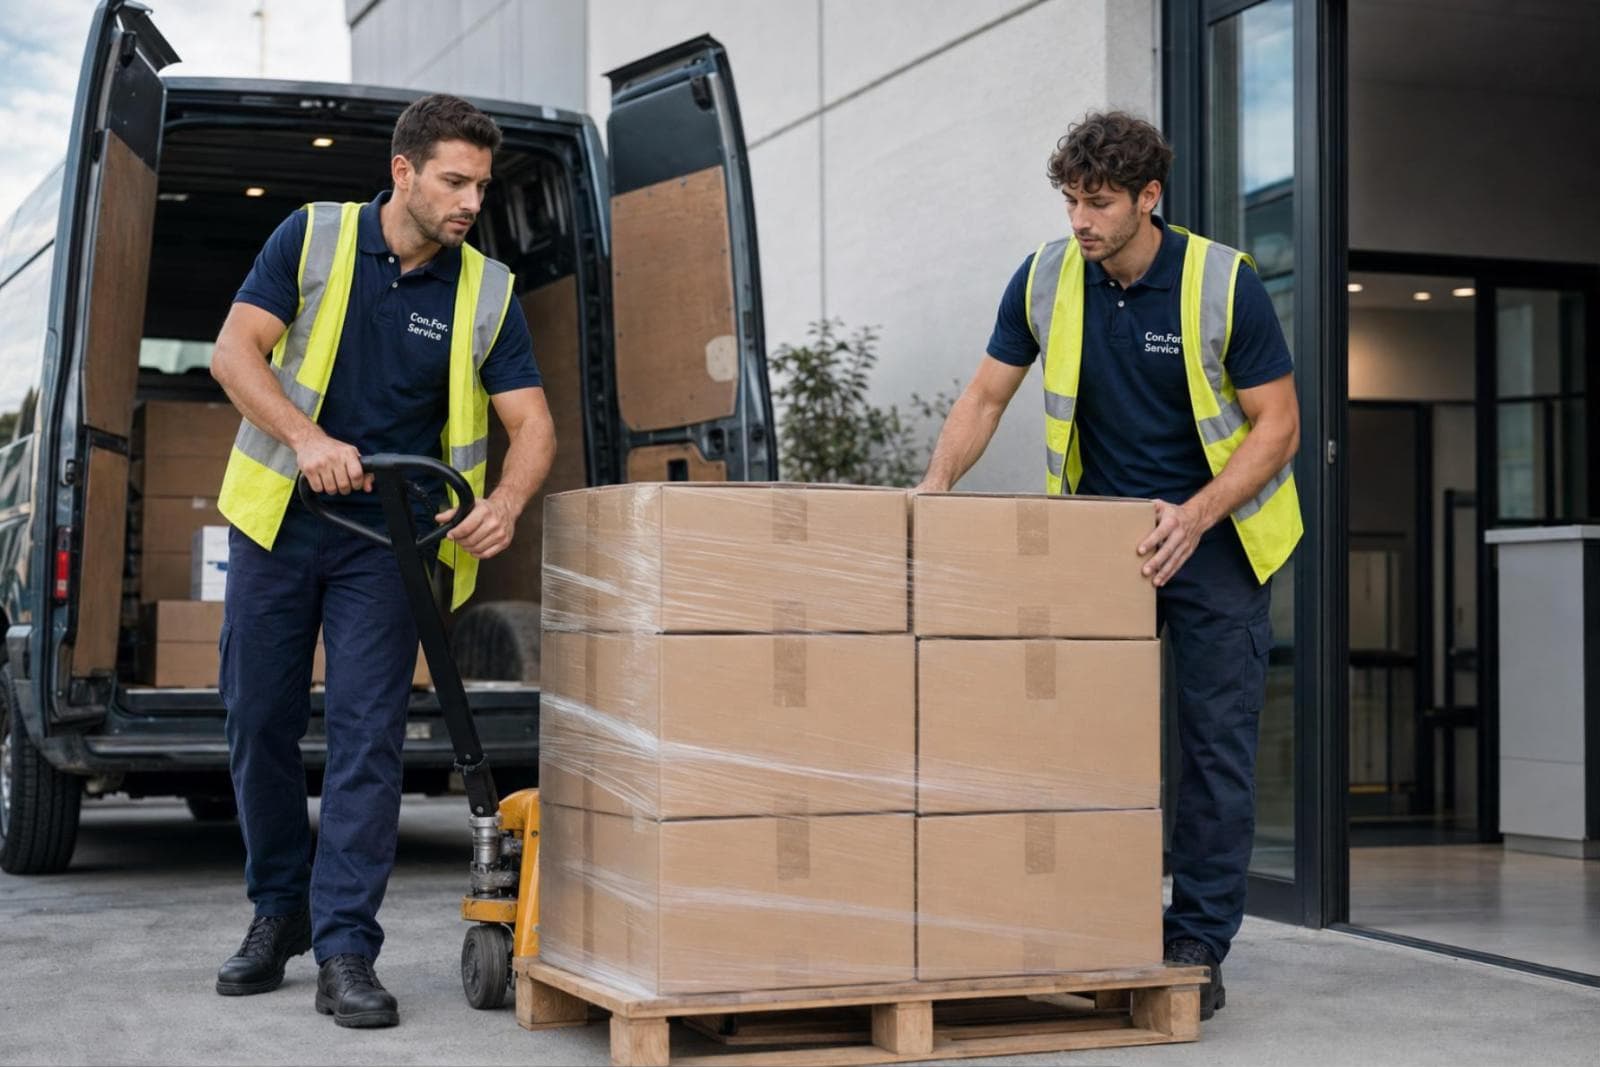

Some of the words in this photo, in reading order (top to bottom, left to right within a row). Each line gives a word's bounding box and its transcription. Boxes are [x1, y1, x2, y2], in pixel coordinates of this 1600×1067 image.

[410, 312, 448, 332] Con.For.
[408, 323, 442, 341] Service
[1144, 343, 1179, 355] Service
